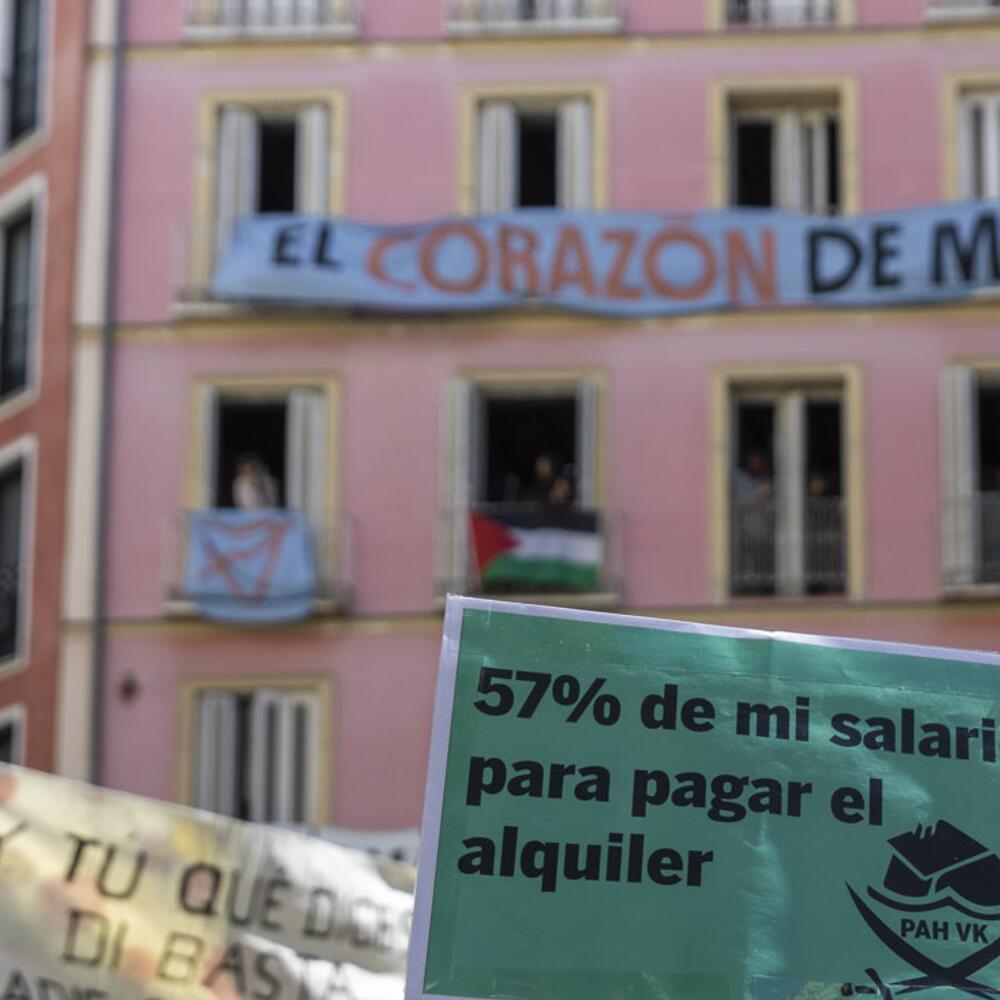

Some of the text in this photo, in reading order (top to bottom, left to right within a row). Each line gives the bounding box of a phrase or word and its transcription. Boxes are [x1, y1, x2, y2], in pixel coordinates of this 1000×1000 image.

[271, 223, 341, 269] EL
[807, 223, 904, 294] DE
[473, 666, 621, 726] 57%
[640, 683, 716, 732] de
[736, 696, 810, 742] mi
[466, 756, 883, 826] para pagar el
[457, 825, 714, 892] alquiler
[61, 906, 126, 970] DI
[901, 918, 989, 944] PAH VK
